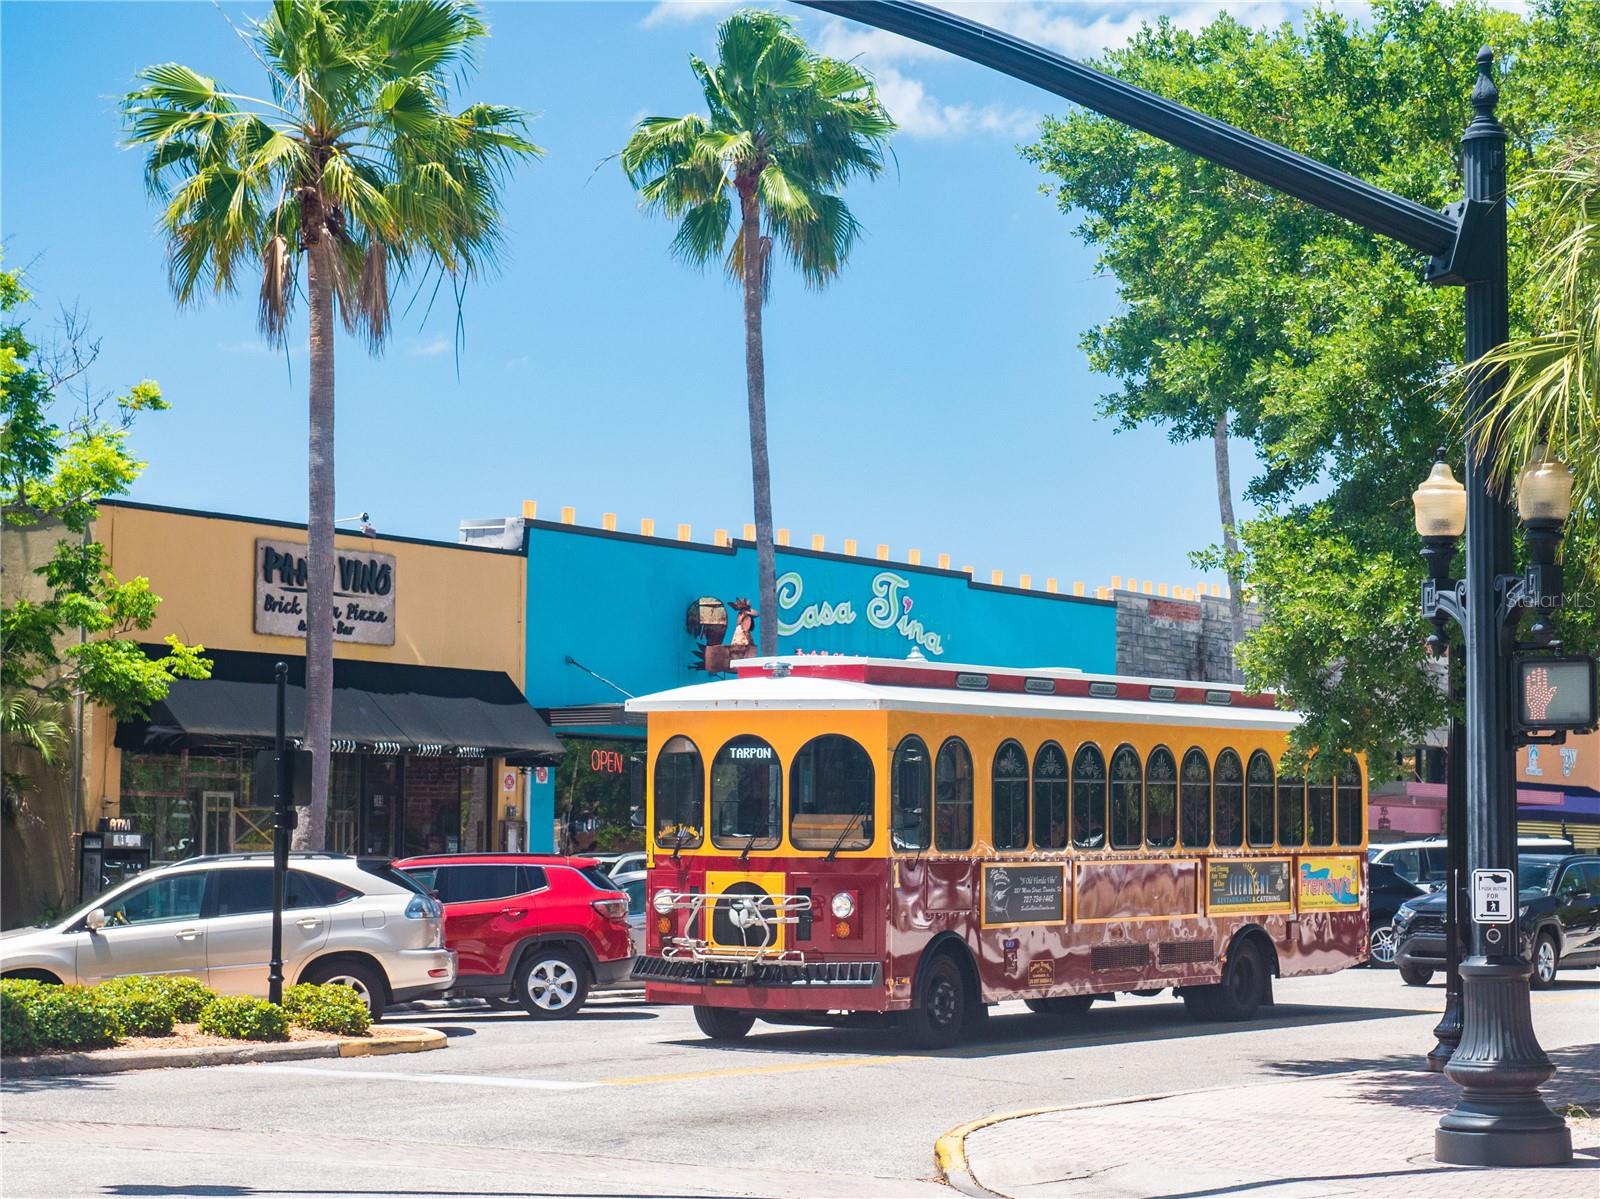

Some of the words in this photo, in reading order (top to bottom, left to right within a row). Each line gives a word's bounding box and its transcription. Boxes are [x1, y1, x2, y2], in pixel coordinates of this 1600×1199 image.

[338, 556, 392, 596] VINO
[263, 593, 302, 616] Brick
[346, 602, 388, 623] Pizza
[776, 572, 856, 636] Casa
[867, 572, 944, 655] Tina
[336, 620, 356, 635] Bar
[591, 749, 624, 774] OPEN
[729, 747, 772, 759] TARPON
[109, 818, 131, 831] ATM
